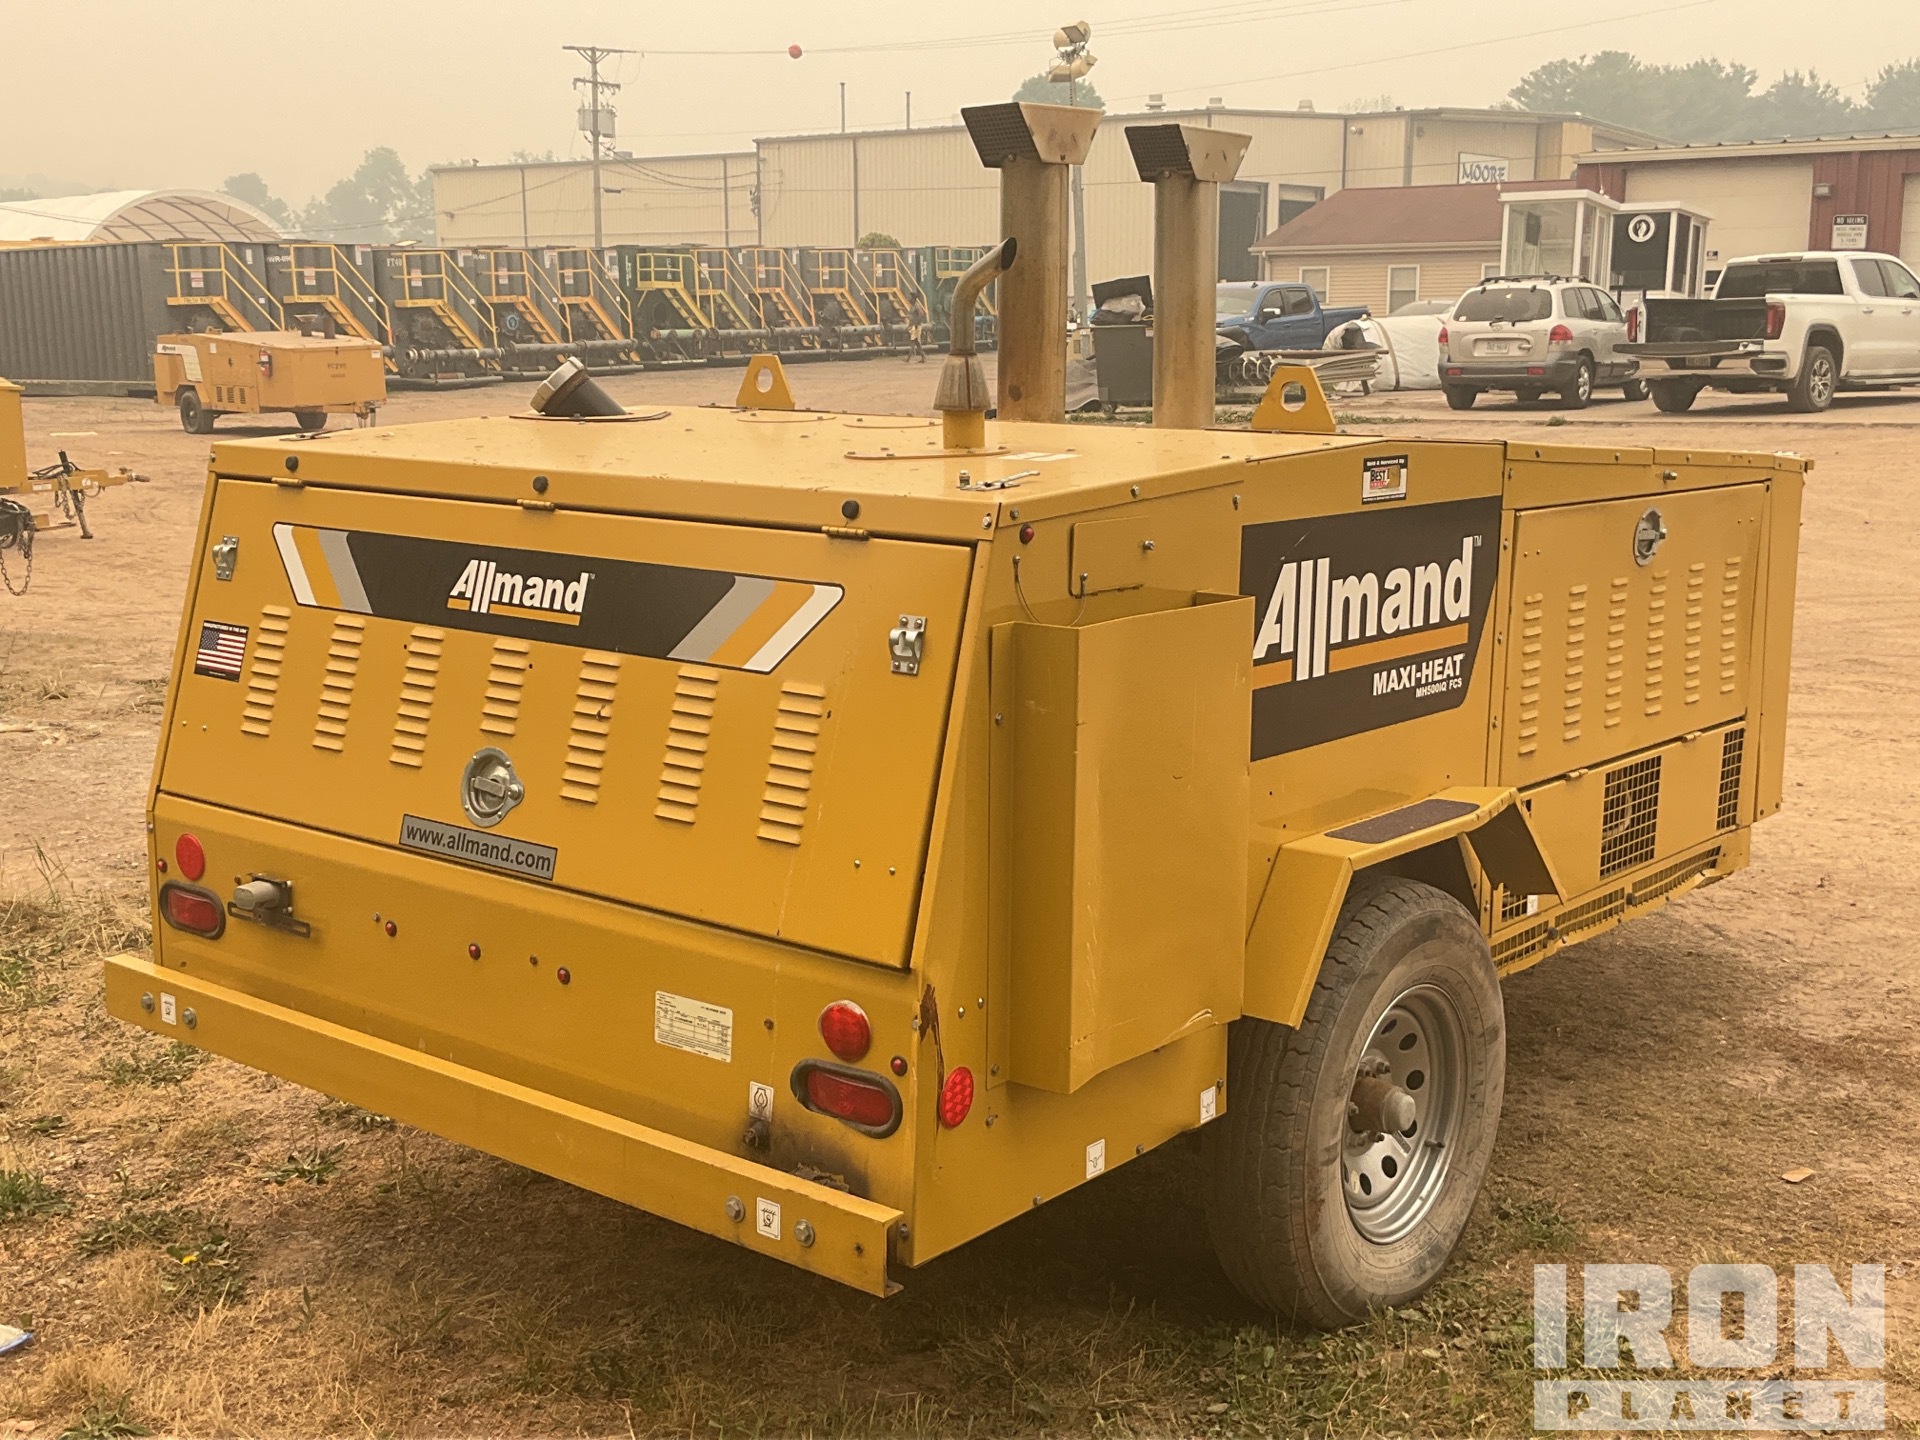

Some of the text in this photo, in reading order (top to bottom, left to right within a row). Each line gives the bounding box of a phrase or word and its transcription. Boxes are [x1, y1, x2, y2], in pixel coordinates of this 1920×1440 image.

[1462, 163, 1506, 183] MOORE
[1836, 217, 1845, 225] NO
[449, 559, 590, 614] Allmand
[1253, 536, 1473, 681] Allmand
[1373, 653, 1465, 696] MAXI-HEAT
[1448, 677, 1463, 690] FCS
[406, 824, 551, 872] www.allmand.com
